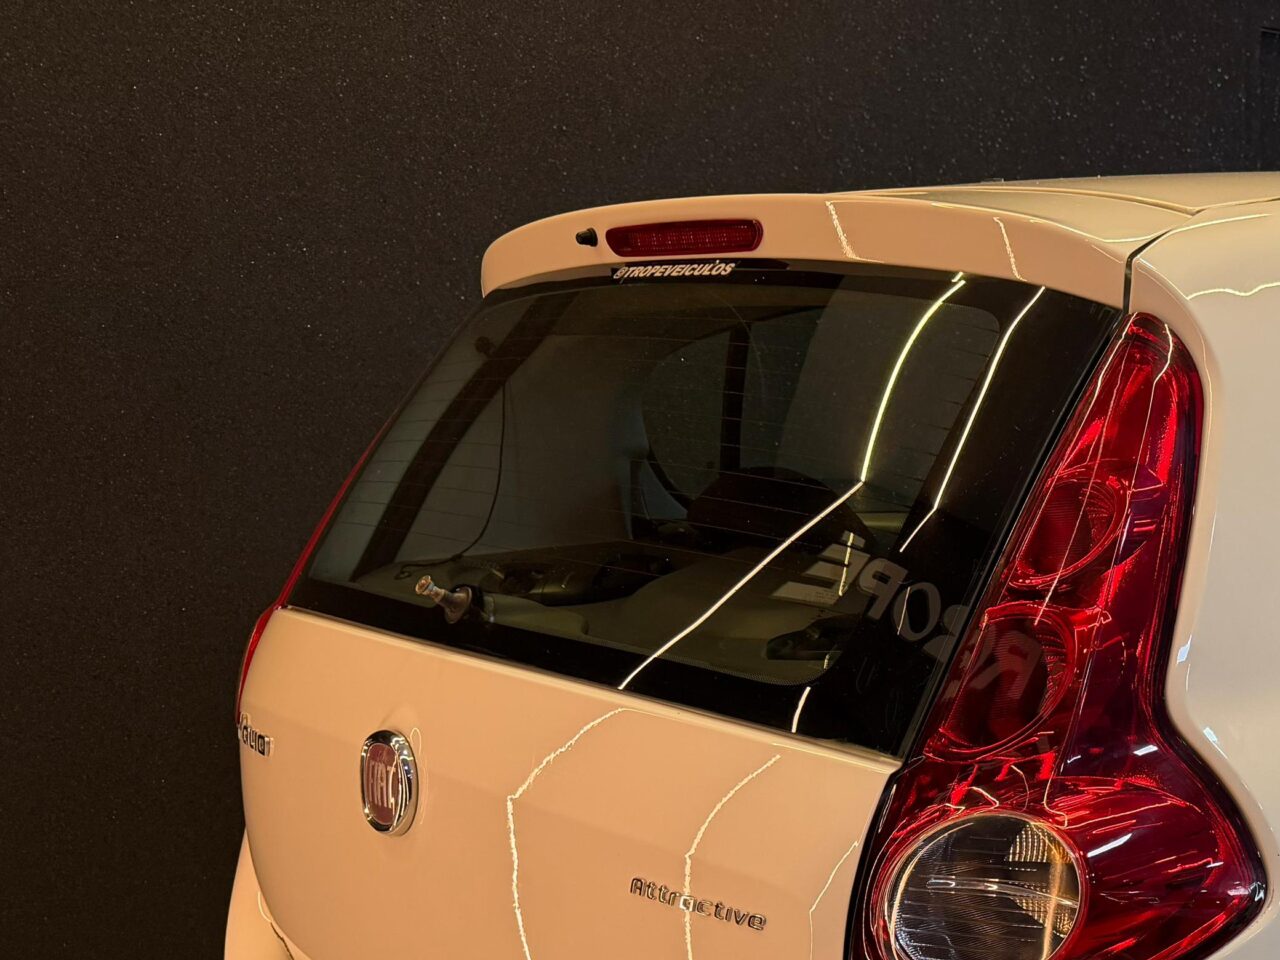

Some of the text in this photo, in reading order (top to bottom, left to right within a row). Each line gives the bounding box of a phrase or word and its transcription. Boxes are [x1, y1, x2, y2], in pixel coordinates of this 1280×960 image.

[613, 262, 736, 280] @TROPEVEICULOS
[368, 761, 397, 809] FIAT
[630, 877, 767, 931] Attractive
